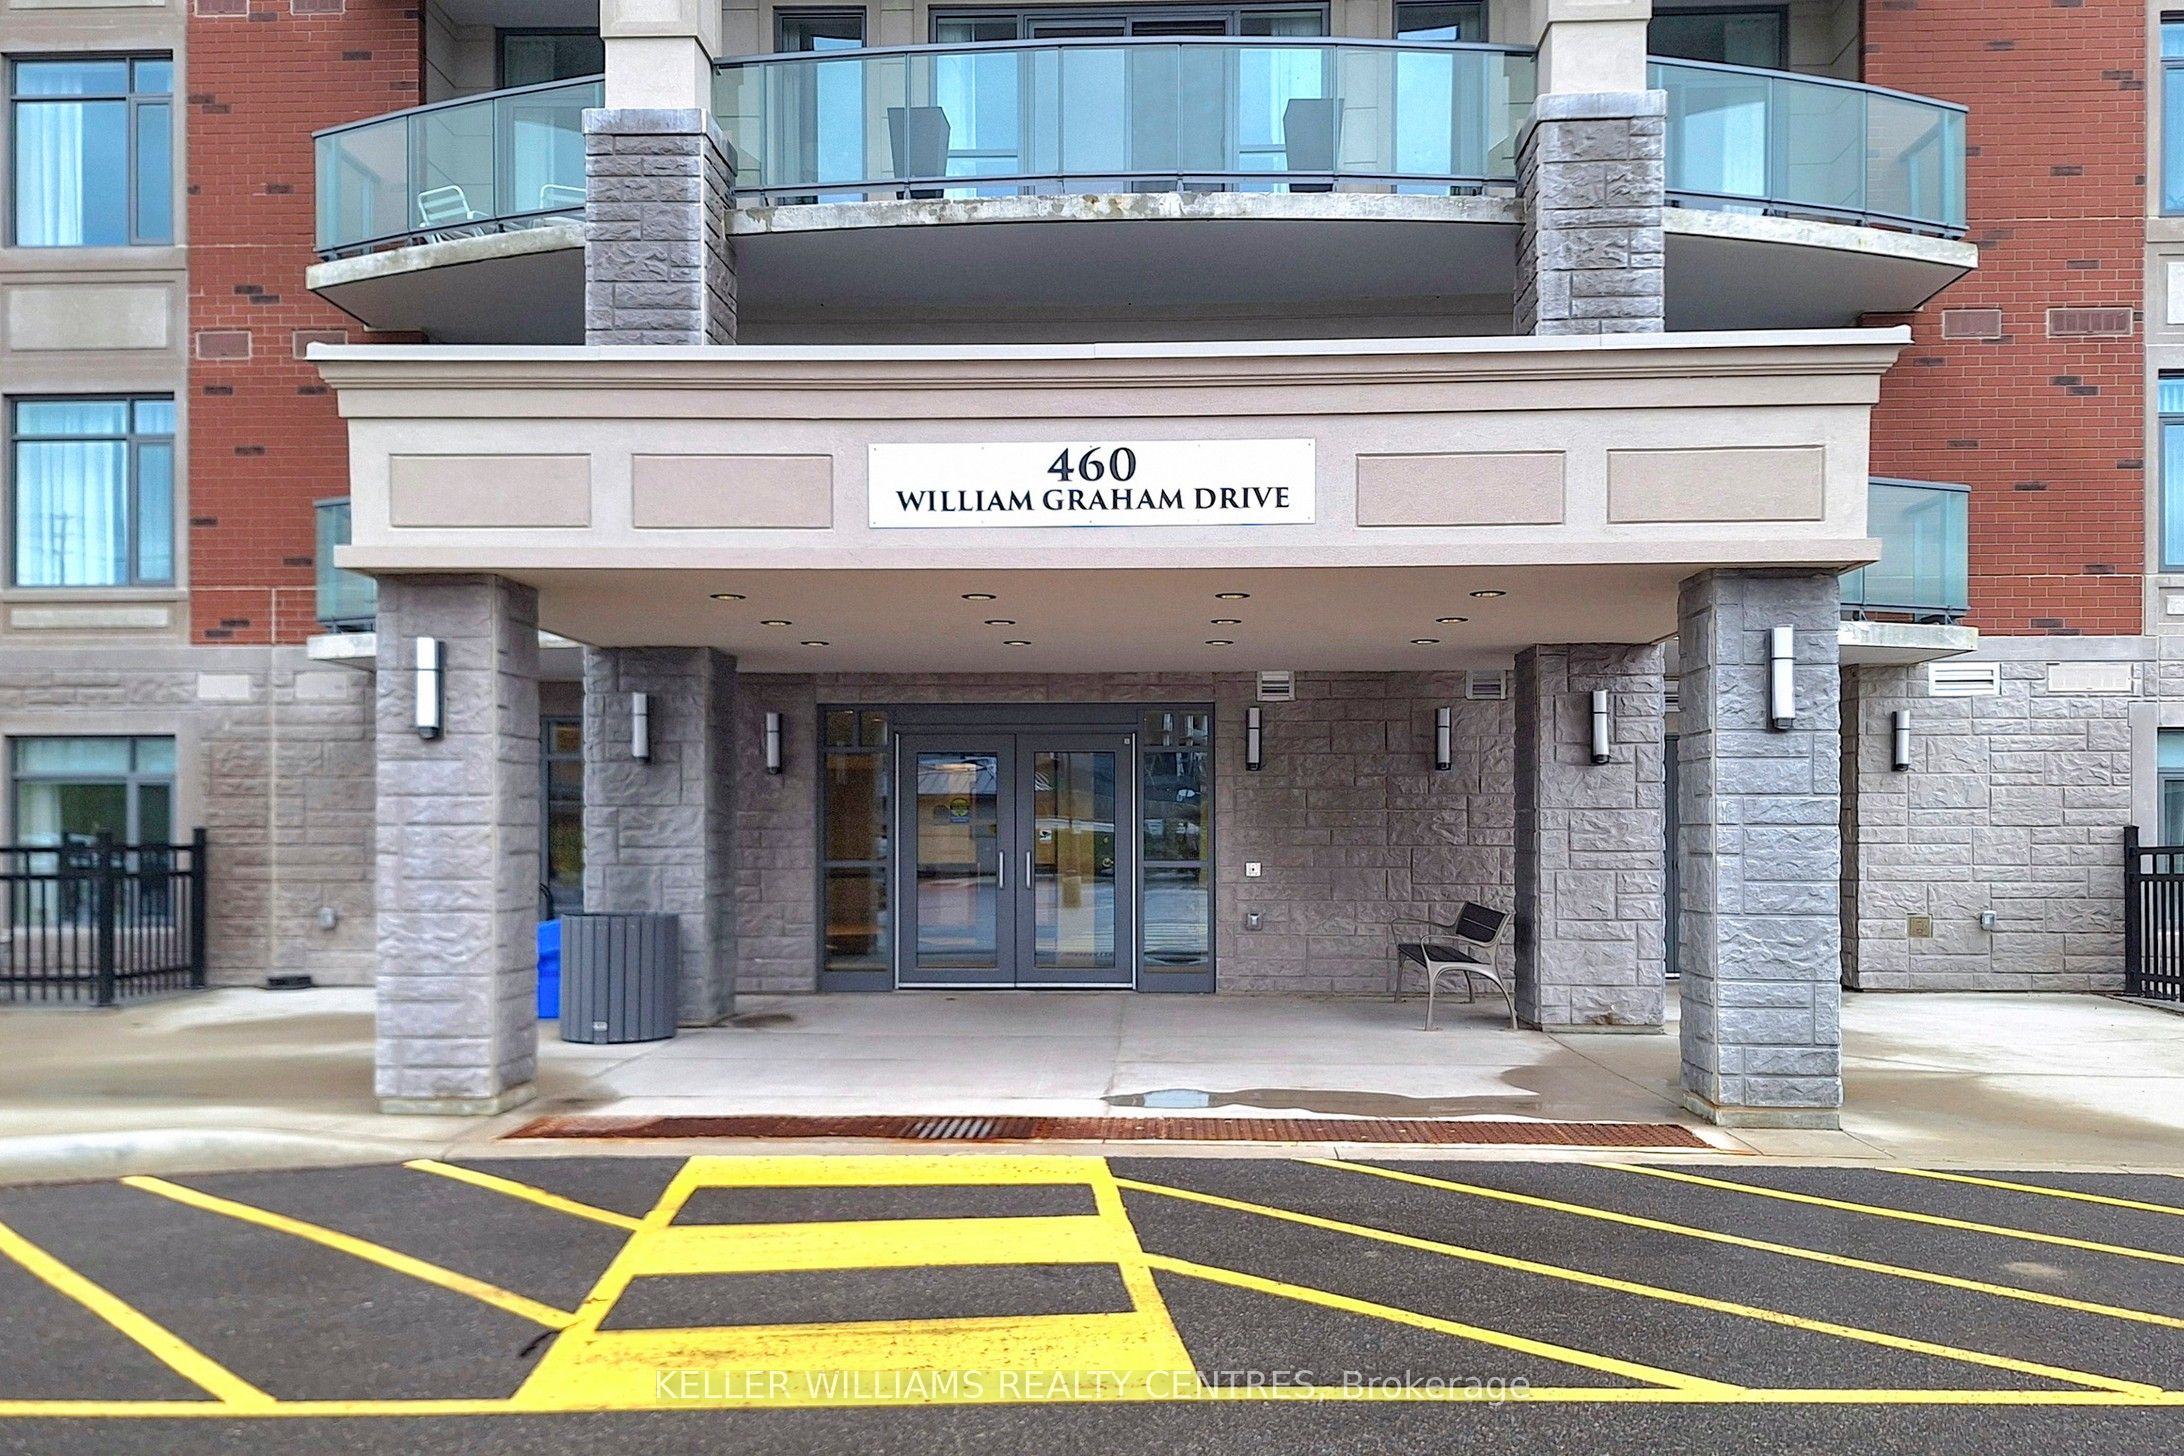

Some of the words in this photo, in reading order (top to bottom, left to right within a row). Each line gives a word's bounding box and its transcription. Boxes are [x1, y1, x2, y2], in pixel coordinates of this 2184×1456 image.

[1047, 446, 1137, 482] 460
[896, 490, 1034, 512] WILLIAM
[1042, 488, 1184, 511] GRAHAM
[1195, 486, 1290, 509] DRIVE
